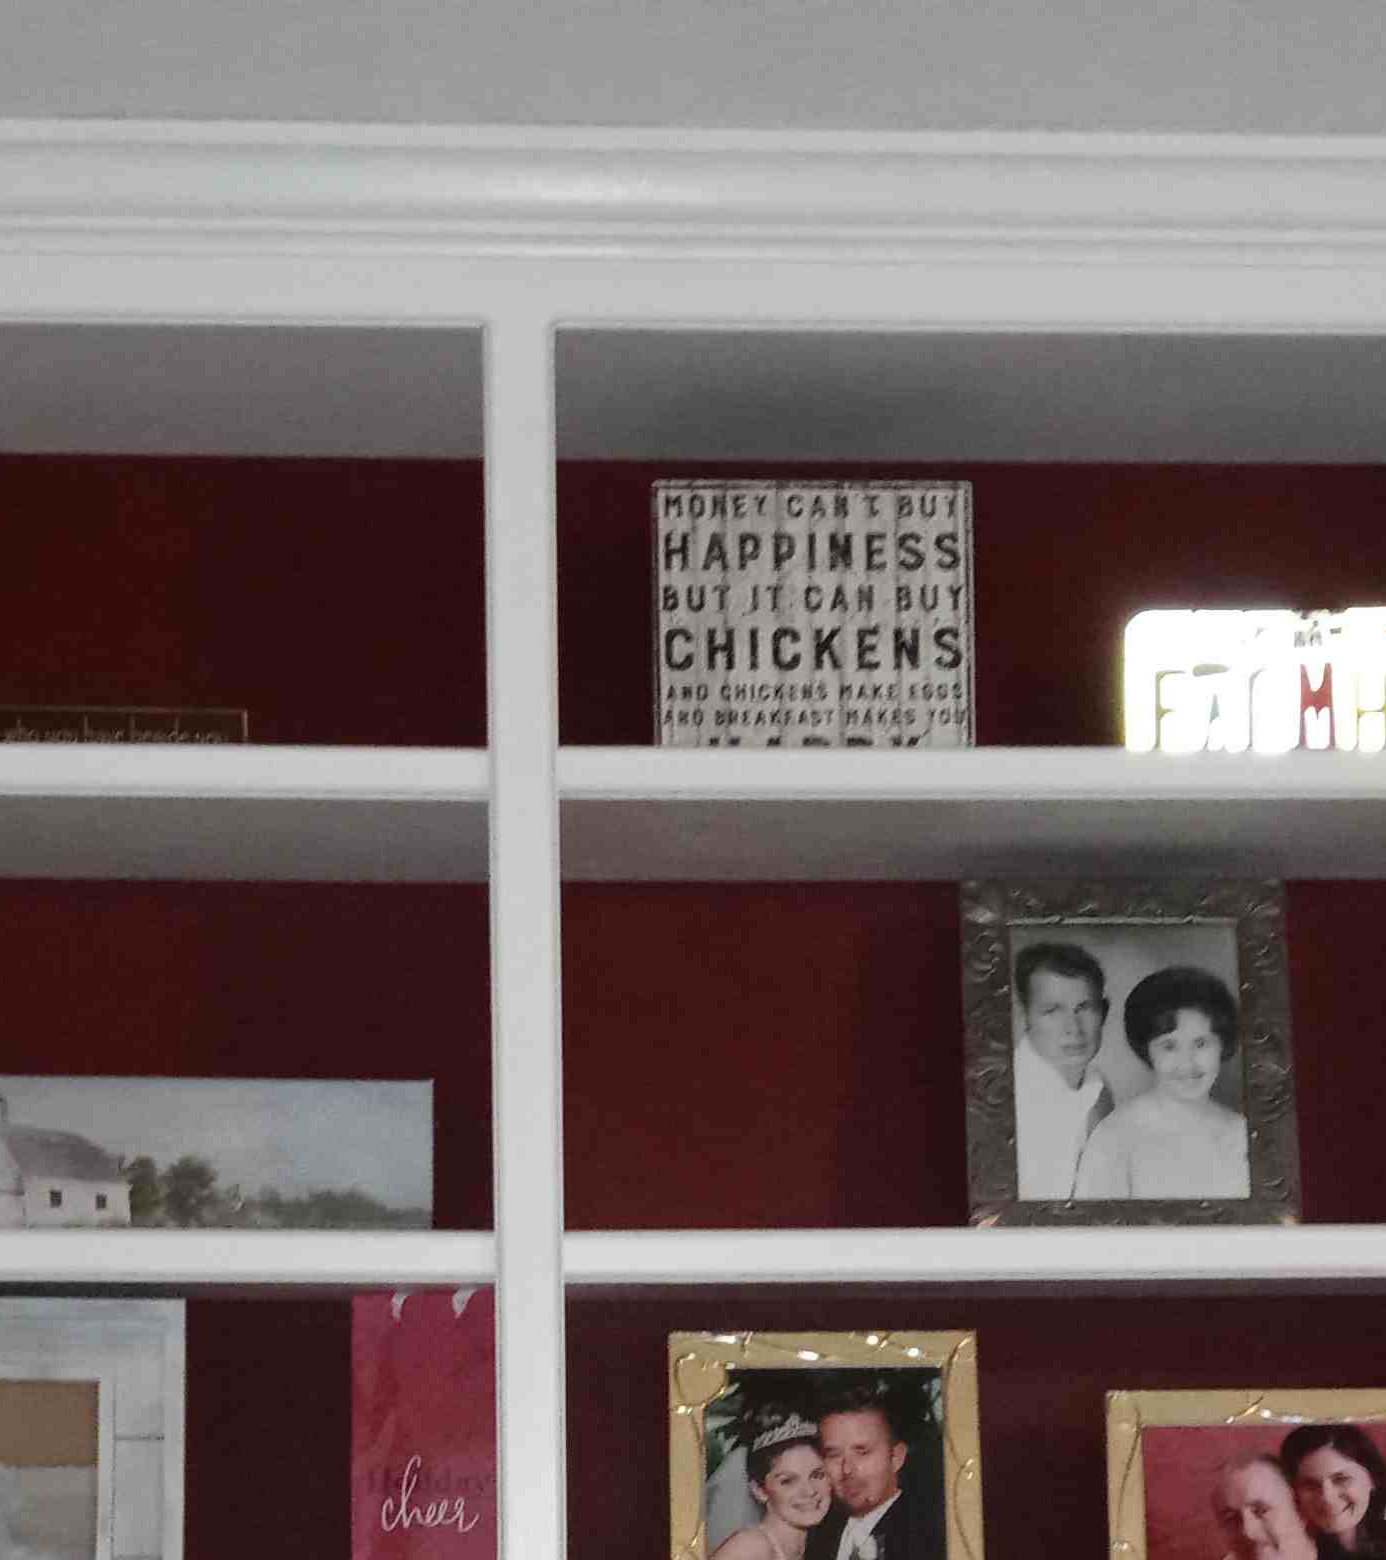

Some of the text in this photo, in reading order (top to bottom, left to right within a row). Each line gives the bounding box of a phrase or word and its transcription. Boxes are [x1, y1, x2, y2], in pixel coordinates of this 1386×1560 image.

[664, 494, 768, 518] MONEY
[896, 494, 959, 518] BUY
[663, 531, 961, 572] HAPPINESS
[663, 583, 962, 613] BUT IT CAN BUY
[665, 627, 963, 671] CHICKENS
[720, 682, 829, 702] CHICKENS
[840, 683, 897, 701] MAKE
[380, 1453, 481, 1534] cheer
